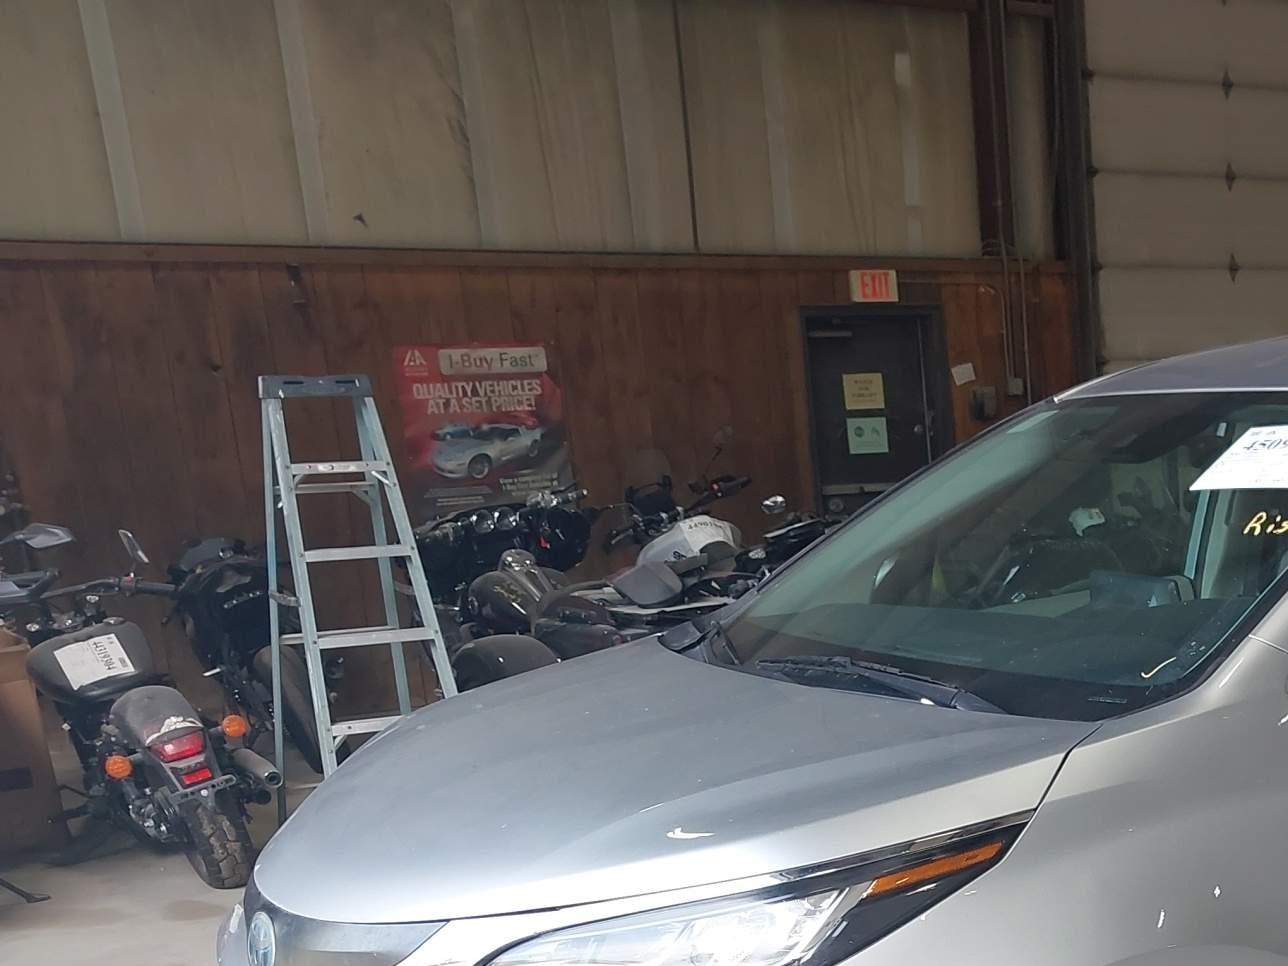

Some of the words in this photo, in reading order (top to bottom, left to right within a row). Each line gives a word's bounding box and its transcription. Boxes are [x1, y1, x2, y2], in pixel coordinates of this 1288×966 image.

[859, 272, 890, 298] EXIT
[500, 351, 535, 367] Fast
[413, 381, 473, 399] QUALITY
[475, 379, 542, 396] VEHICLES
[427, 400, 449, 415] AT
[450, 399, 462, 414] A
[463, 397, 490, 413] SET
[492, 395, 536, 412] PRICE!
